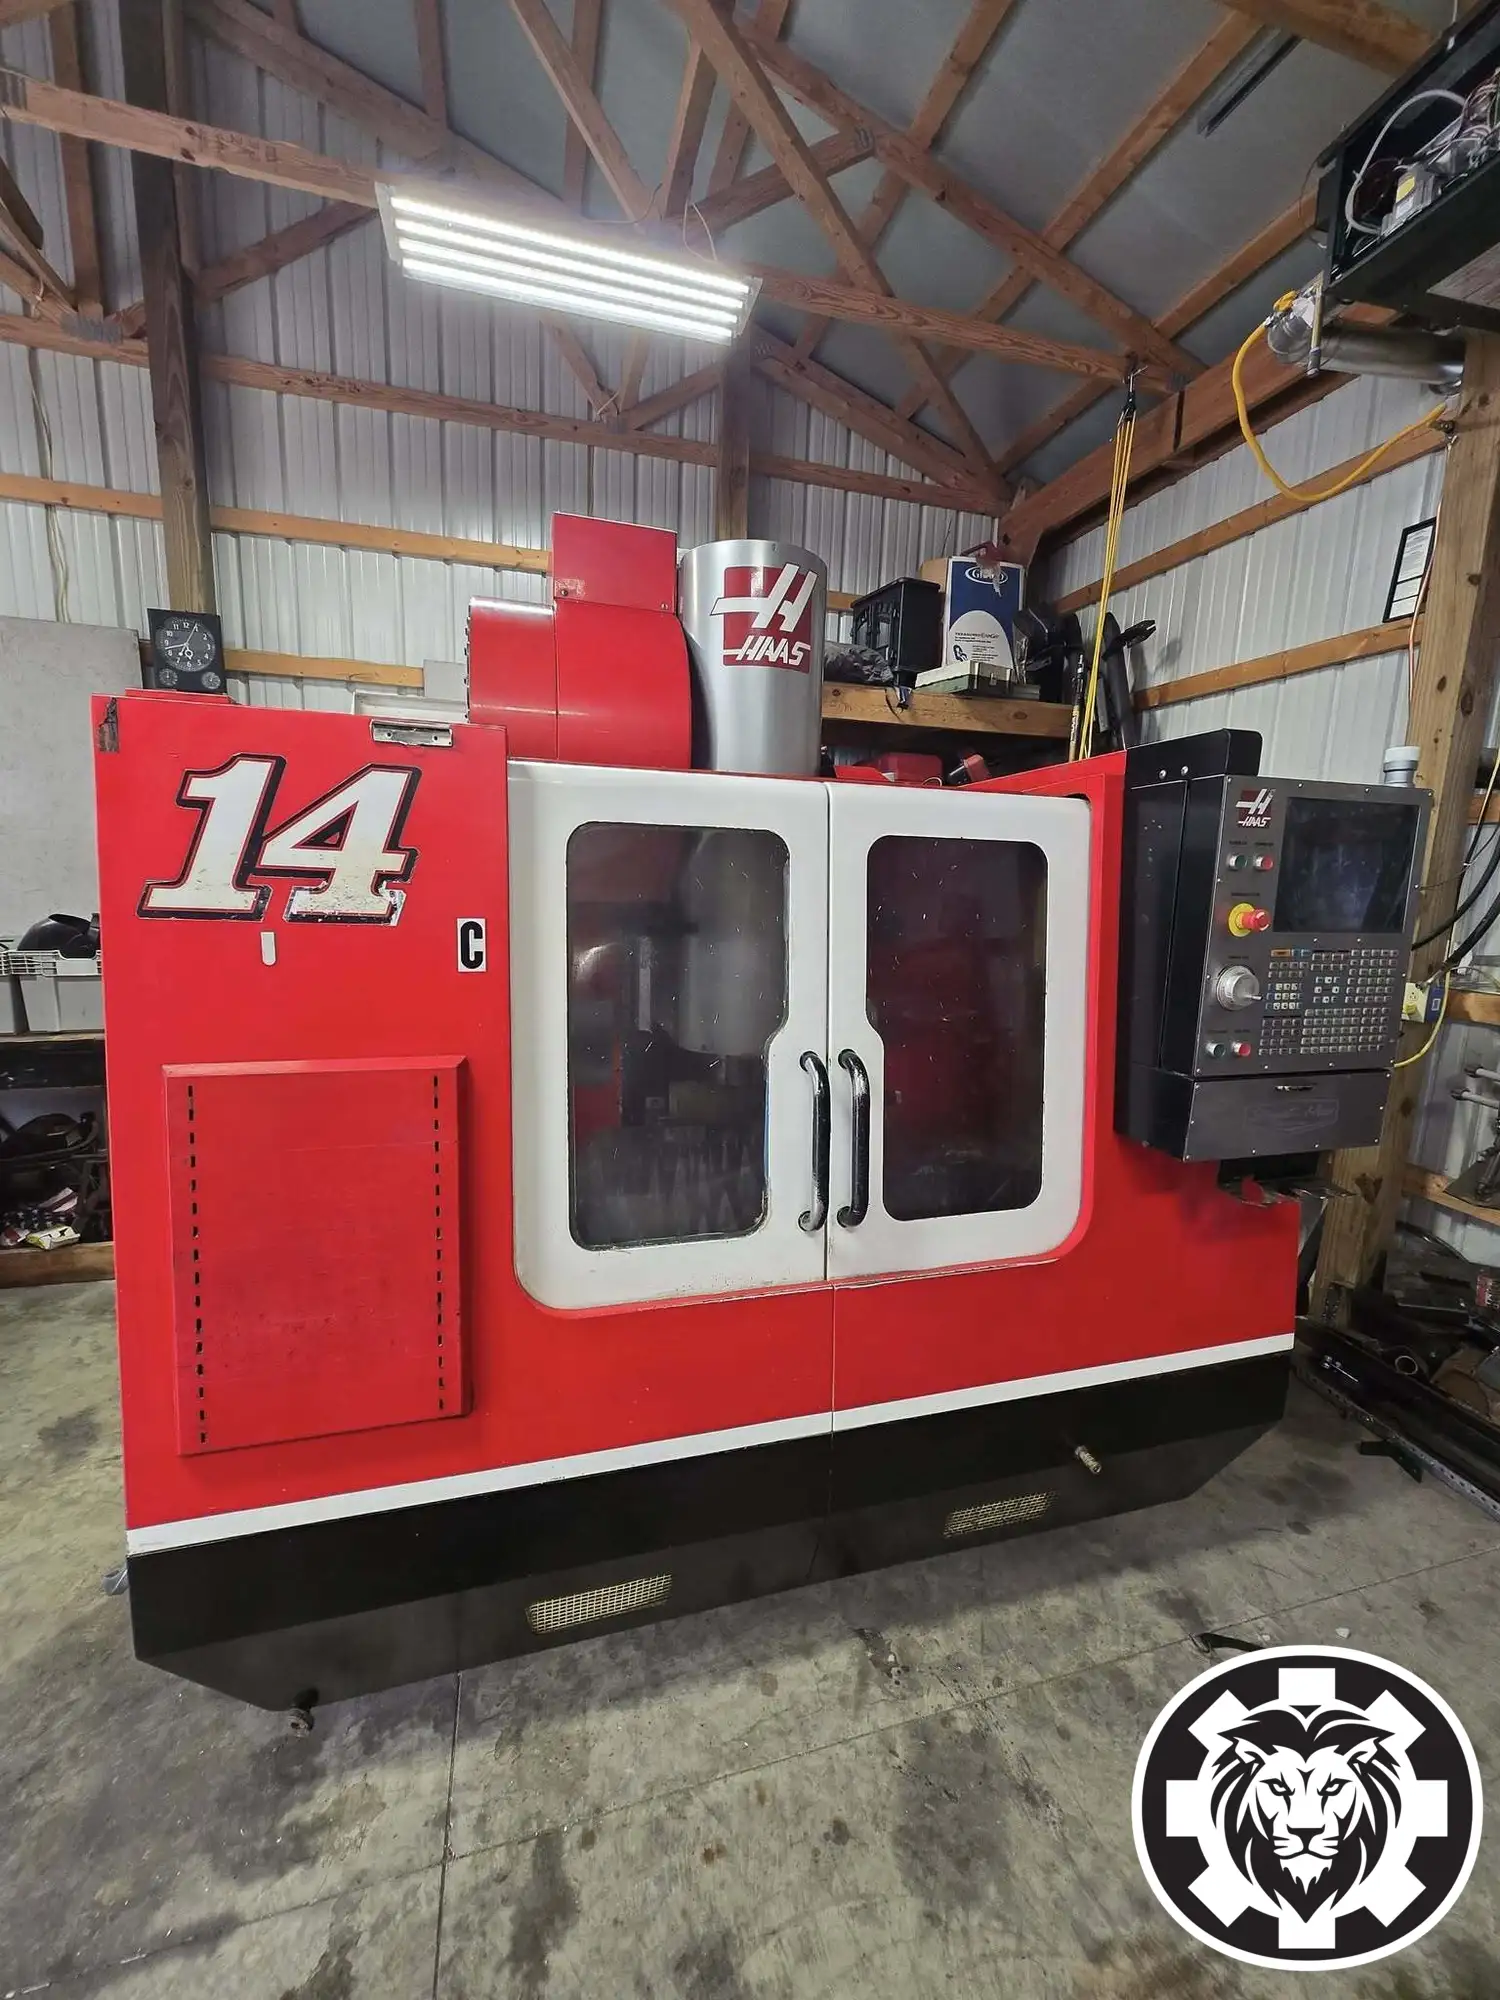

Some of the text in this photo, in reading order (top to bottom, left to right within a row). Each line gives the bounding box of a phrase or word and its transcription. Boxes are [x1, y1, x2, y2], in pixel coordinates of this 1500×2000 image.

[721, 635, 811, 666] HAAS
[137, 754, 422, 925] 14
[1237, 816, 1271, 827] HAAS
[460, 921, 483, 969] C
